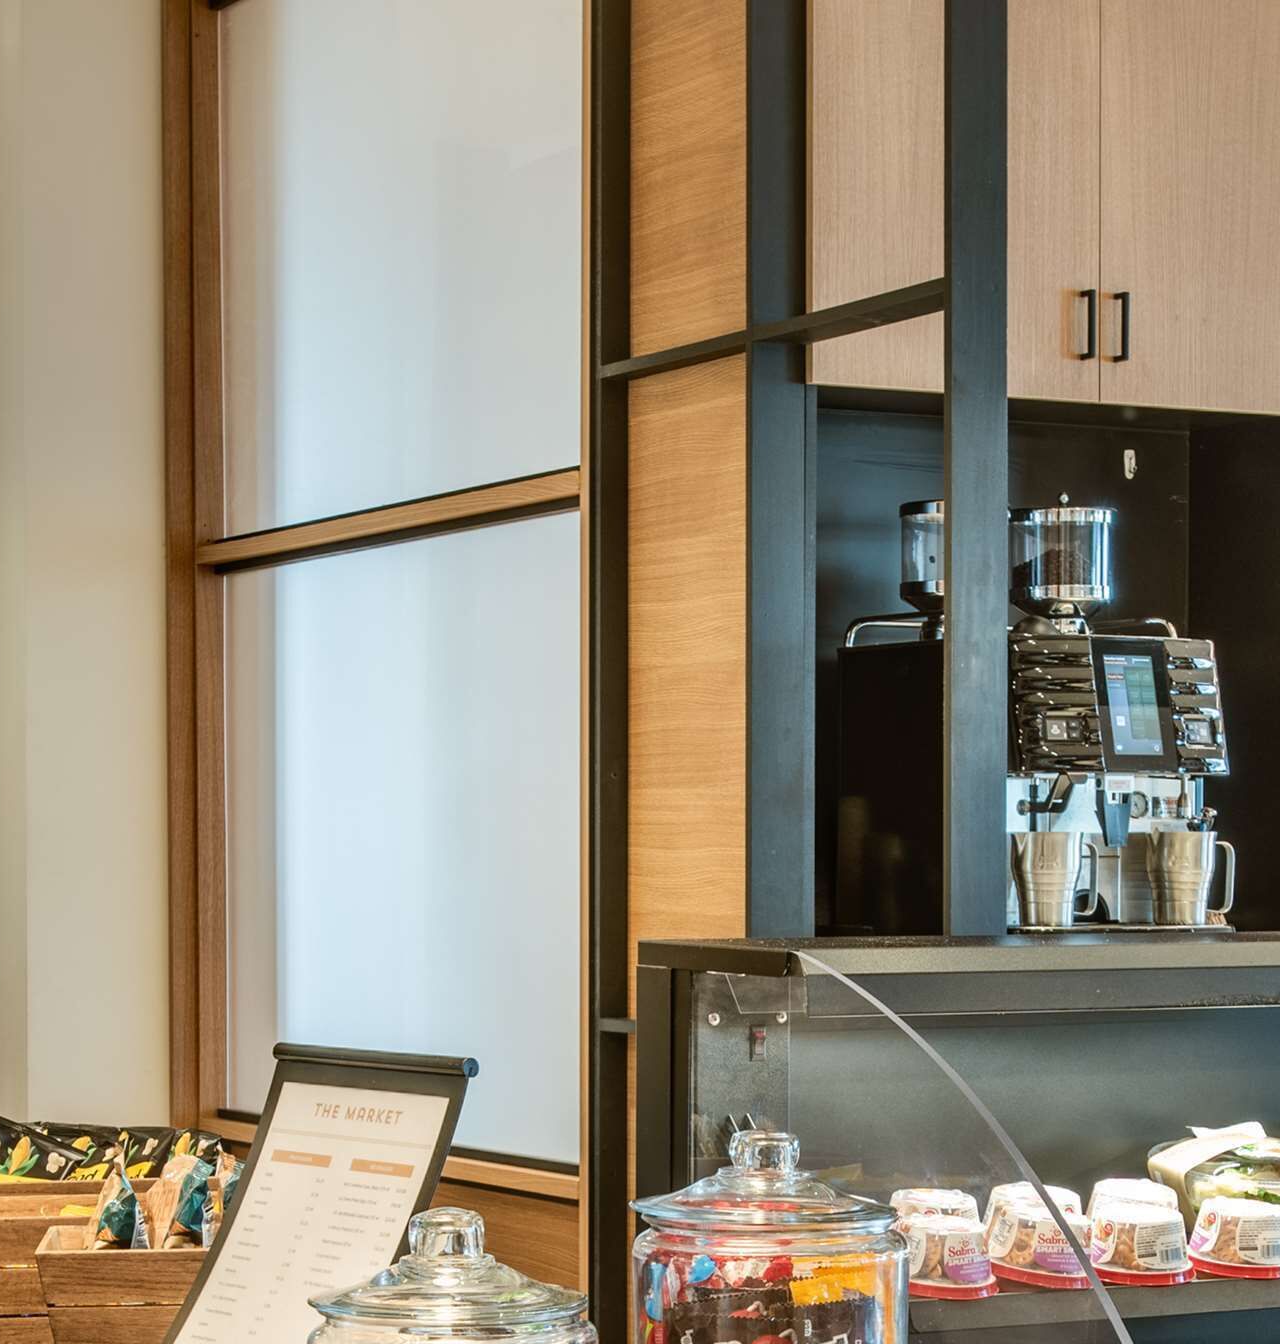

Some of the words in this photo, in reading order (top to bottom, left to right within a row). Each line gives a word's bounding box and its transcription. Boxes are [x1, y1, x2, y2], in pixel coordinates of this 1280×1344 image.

[313, 1103, 341, 1119] THE
[345, 1107, 404, 1125] MARKET
[947, 1246, 976, 1258] Sabra
